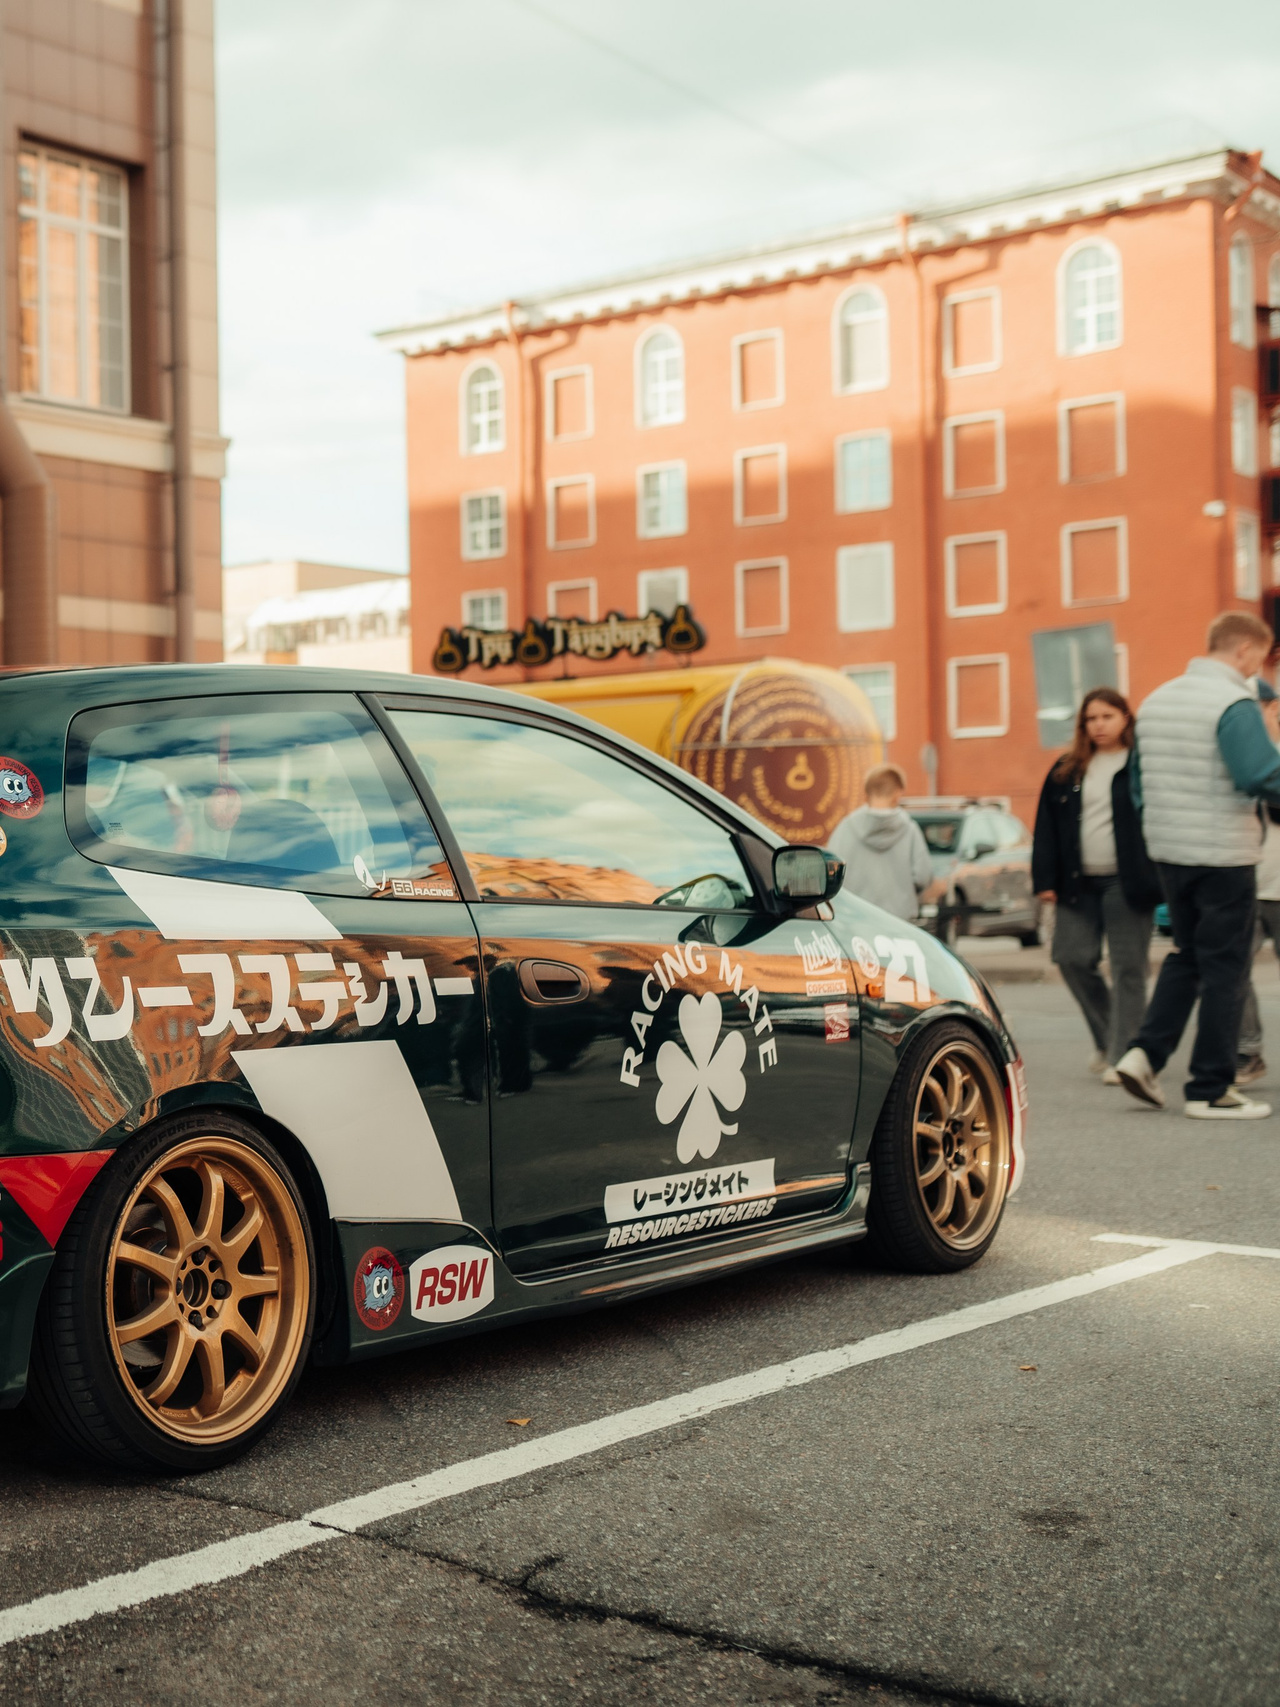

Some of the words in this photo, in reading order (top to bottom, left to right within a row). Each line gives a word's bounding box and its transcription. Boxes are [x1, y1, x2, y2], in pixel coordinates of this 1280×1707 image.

[394, 882, 412, 894] 56
[413, 881, 452, 890] GRATCH
[414, 888, 454, 897] RACING
[807, 982, 846, 994] COPCHICK
[874, 935, 932, 1003] 27
[620, 940, 708, 1088] RACING
[718, 950, 778, 1074] MATE
[632, 1170, 750, 1212] レーシングメイト
[605, 1196, 777, 1250] RESOURCESTICKERS
[415, 1257, 489, 1310] RSW
